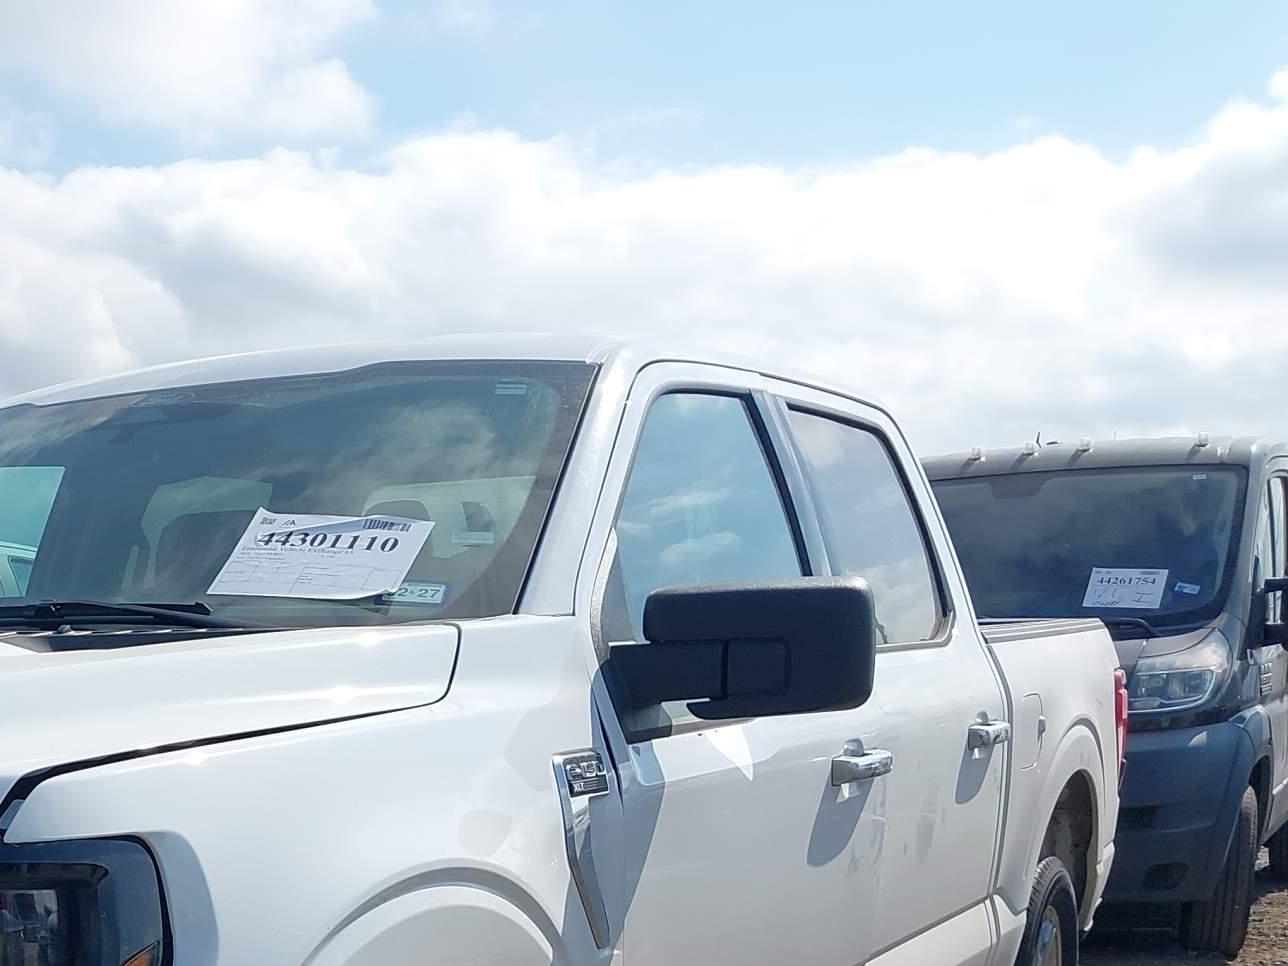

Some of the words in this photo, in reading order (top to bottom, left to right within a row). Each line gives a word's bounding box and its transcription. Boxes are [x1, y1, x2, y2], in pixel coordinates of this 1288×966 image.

[257, 532, 399, 552] 44301110
[1096, 576, 1157, 585] 44261754
[573, 783, 585, 793] XLT
